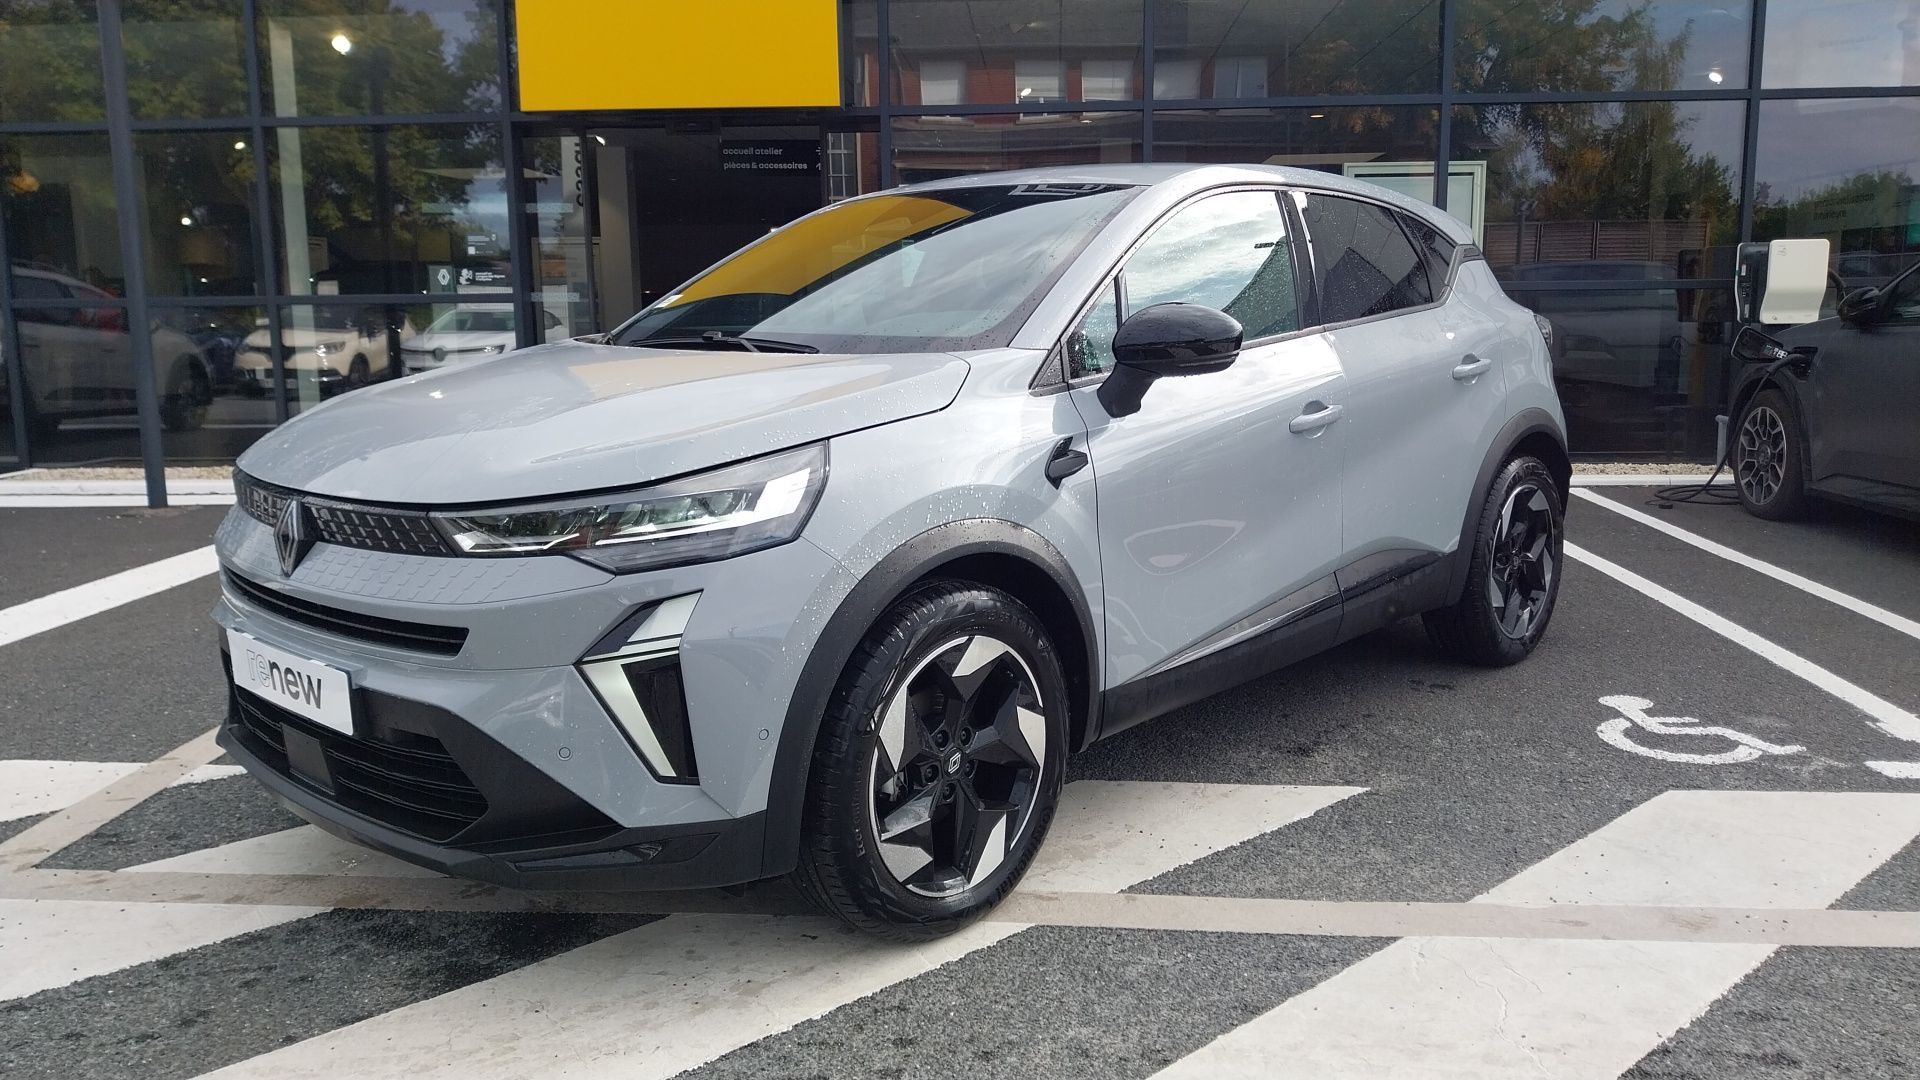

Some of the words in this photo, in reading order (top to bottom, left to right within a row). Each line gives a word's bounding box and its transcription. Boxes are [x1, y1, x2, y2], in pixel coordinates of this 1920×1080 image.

[723, 147, 753, 155] accueil
[755, 147, 783, 155] atelier
[723, 162, 750, 171] pièces
[246, 648, 322, 710] renew
